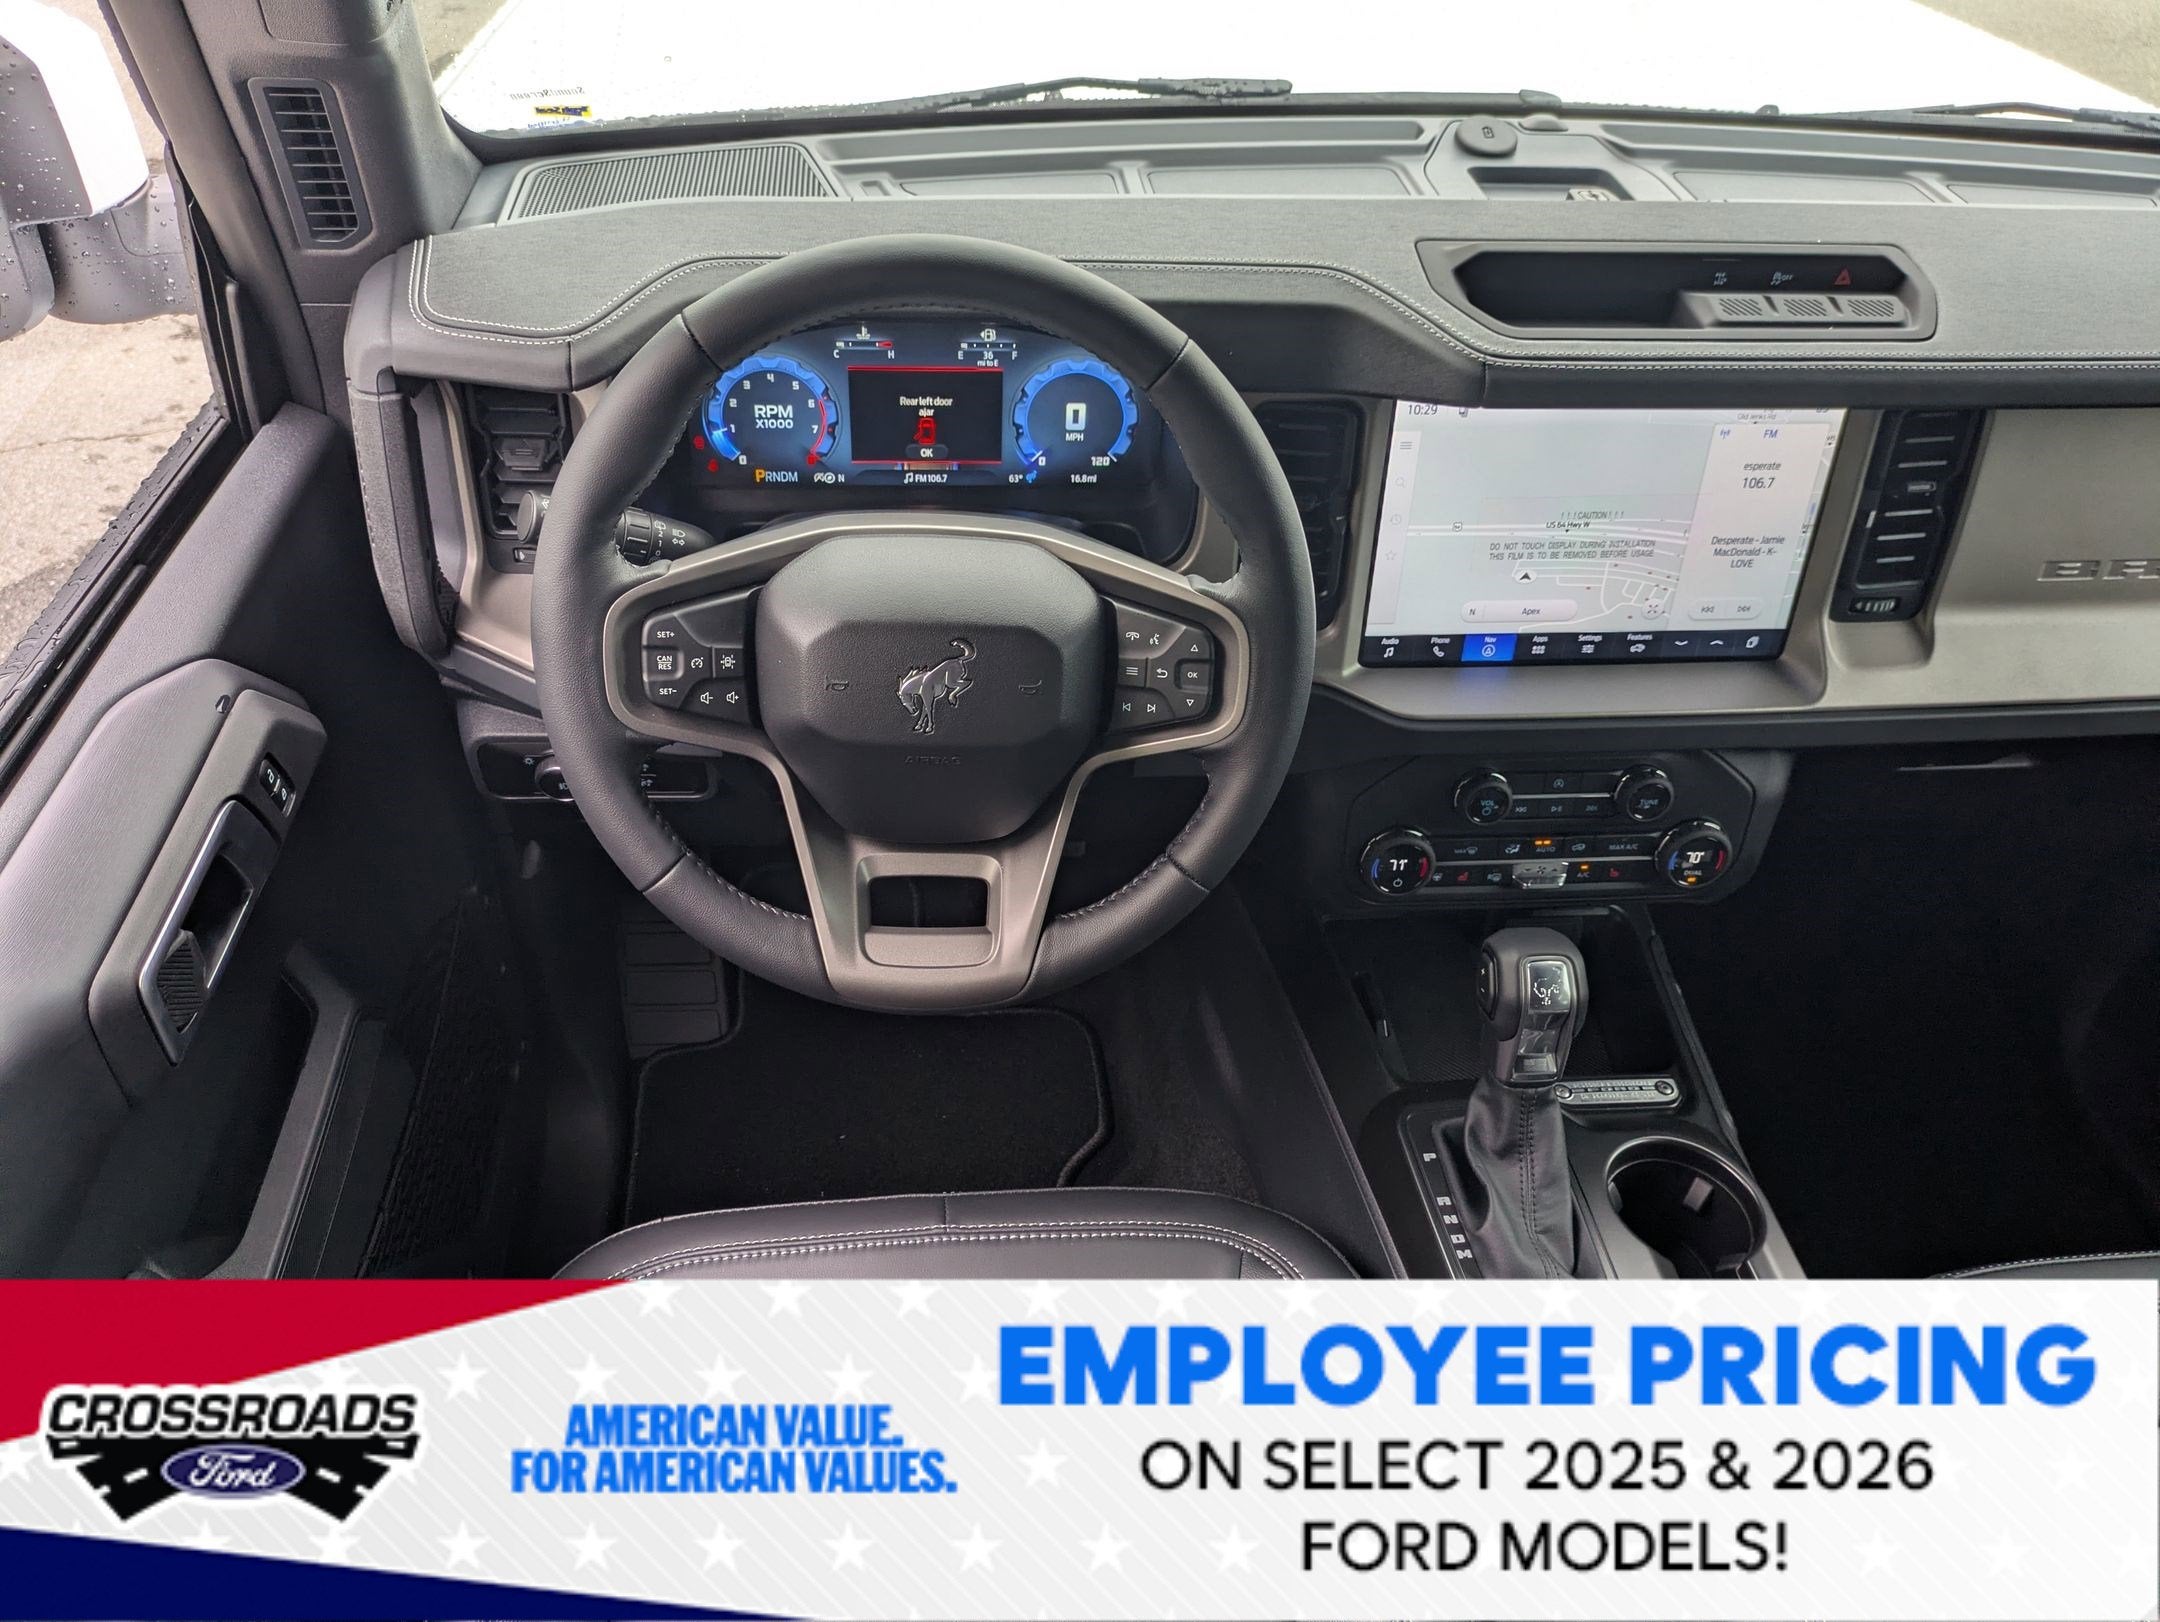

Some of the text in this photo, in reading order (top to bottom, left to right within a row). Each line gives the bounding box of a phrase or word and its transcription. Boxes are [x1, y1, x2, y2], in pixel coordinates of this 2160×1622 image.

[833, 350, 840, 358] C
[888, 351, 895, 359] H
[958, 351, 964, 360] E
[1012, 351, 1018, 360] F
[767, 373, 775, 382] 4
[743, 380, 751, 390] 3
[792, 381, 800, 390] 5
[729, 398, 737, 408] 2
[808, 399, 815, 409] 6
[900, 396, 953, 406] Rear left door
[754, 405, 793, 418] RPM
[919, 409, 934, 417] ajar
[1407, 404, 1438, 415] 10:29
[1065, 403, 1086, 430] 0
[730, 424, 736, 433] 1
[756, 419, 793, 429] X1000
[812, 425, 818, 434] 7
[1763, 429, 1778, 439] FM
[1066, 433, 1084, 442] MPH
[920, 449, 933, 458] OK
[739, 455, 747, 465] 0
[1038, 456, 1046, 466] 0
[1091, 456, 1110, 466] 120
[1743, 462, 1781, 472] esperate
[838, 475, 845, 483] N
[1742, 477, 1775, 489] 106.7
[1490, 543, 1500, 551] DO
[1504, 543, 1518, 551] NOT
[1548, 541, 1576, 549] DISPLAY
[1580, 541, 1606, 549] DURING
[1609, 540, 1656, 549] INSTALLATION
[1711, 536, 1753, 546] Desperate
[1760, 536, 1785, 545] Jamie
[1507, 552, 1523, 560] FILM
[1527, 552, 1534, 560] IS
[1538, 551, 1547, 559] TO
[1550, 551, 1559, 559] BE
[1563, 551, 1597, 559] REMOVED
[1600, 550, 1627, 558] BEFORE
[1631, 550, 1654, 558] USAGE
[1713, 547, 1760, 557] MacDonald
[1730, 559, 1754, 568] LOVE
[1470, 607, 1476, 615] N
[1522, 607, 1541, 616] Apex
[1381, 637, 1399, 645] Audio
[1430, 637, 1450, 645] Phone
[1484, 635, 1497, 643] Nav
[1532, 635, 1549, 644] Apps
[1577, 634, 1603, 643] Settings
[1627, 633, 1652, 641] Features
[1187, 671, 1198, 679] OK
[1423, 1153, 1437, 1162] P
[1443, 1214, 1459, 1224] N
[1450, 1234, 1466, 1244] D
[1456, 1249, 1473, 1259] M
